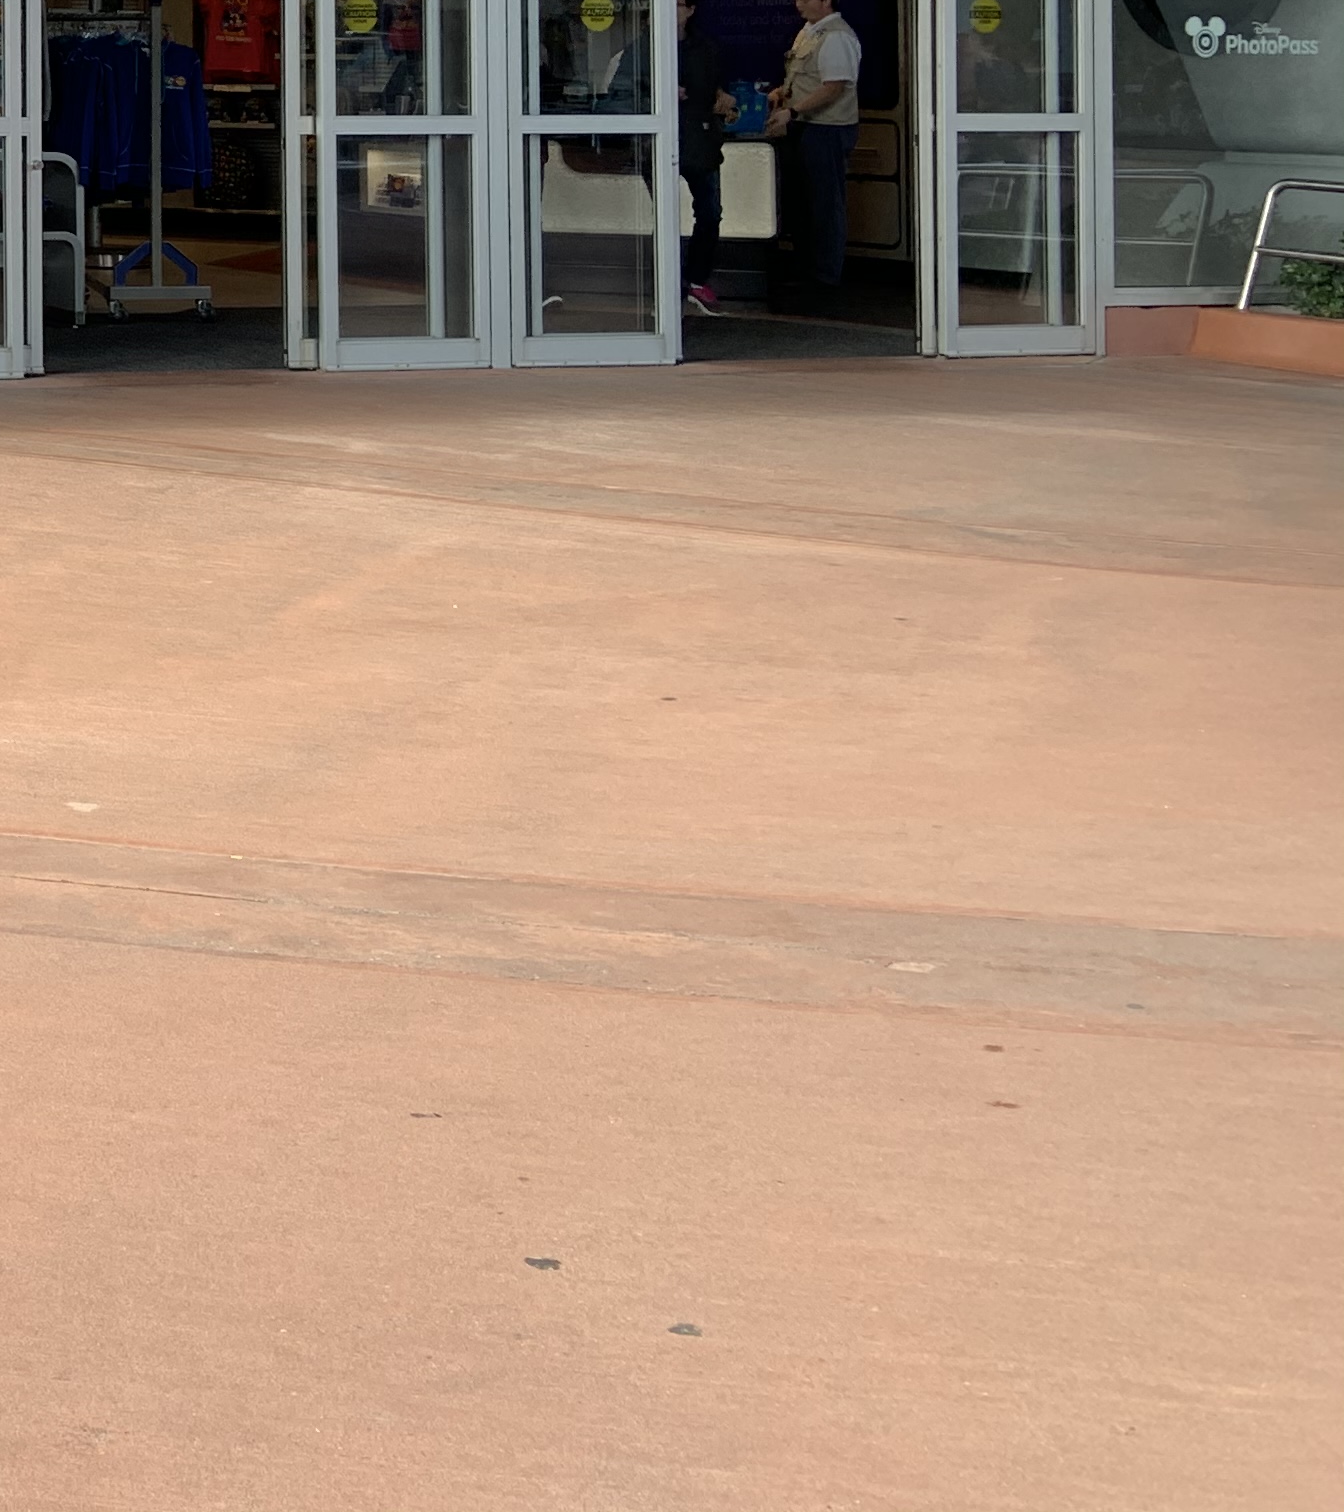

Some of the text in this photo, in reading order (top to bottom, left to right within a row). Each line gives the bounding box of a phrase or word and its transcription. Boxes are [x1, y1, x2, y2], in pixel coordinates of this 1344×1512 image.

[344, 10, 377, 18] CAUTION
[581, 8, 614, 16] CAUTION
[1252, 21, 1282, 36] Disney
[1225, 33, 1319, 55] PhotoPass
